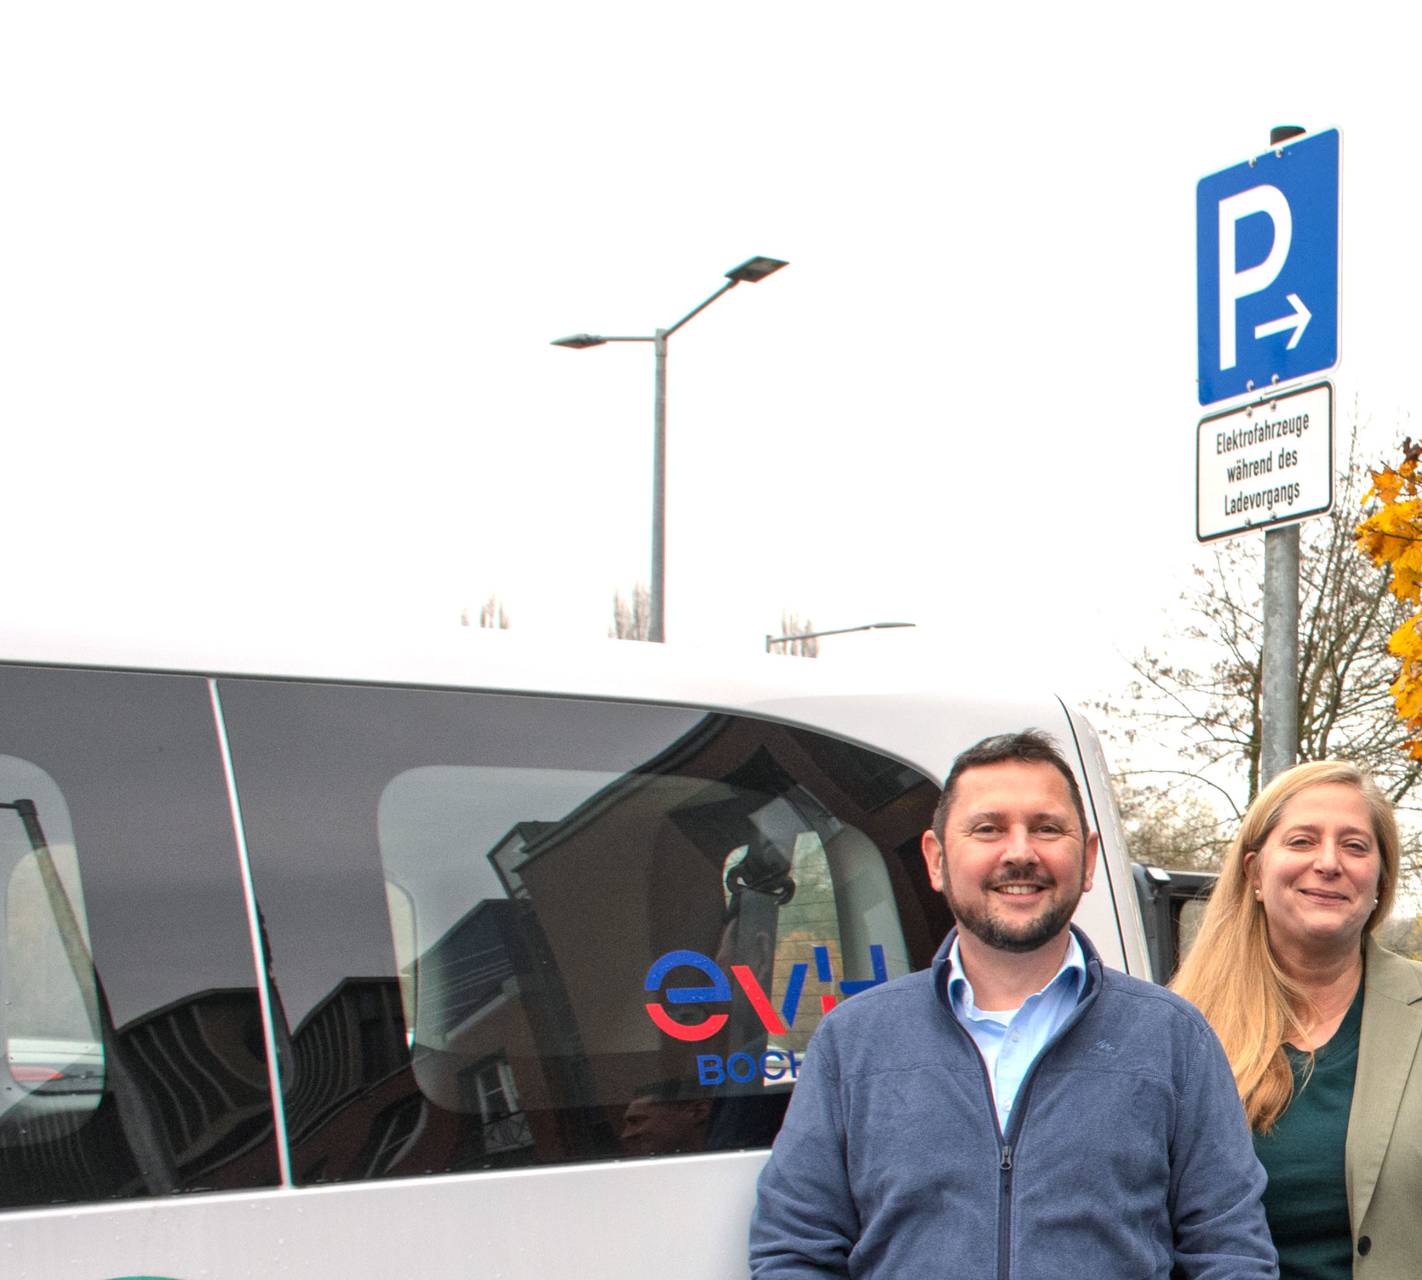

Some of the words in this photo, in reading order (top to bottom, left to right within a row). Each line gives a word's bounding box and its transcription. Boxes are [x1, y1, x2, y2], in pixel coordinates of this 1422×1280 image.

[1219, 184, 1292, 371] P
[1216, 413, 1310, 455] Elektrofahrzeuge
[1227, 450, 1273, 483] während
[1278, 447, 1298, 470] des
[1224, 482, 1301, 516] Ladevorgangs
